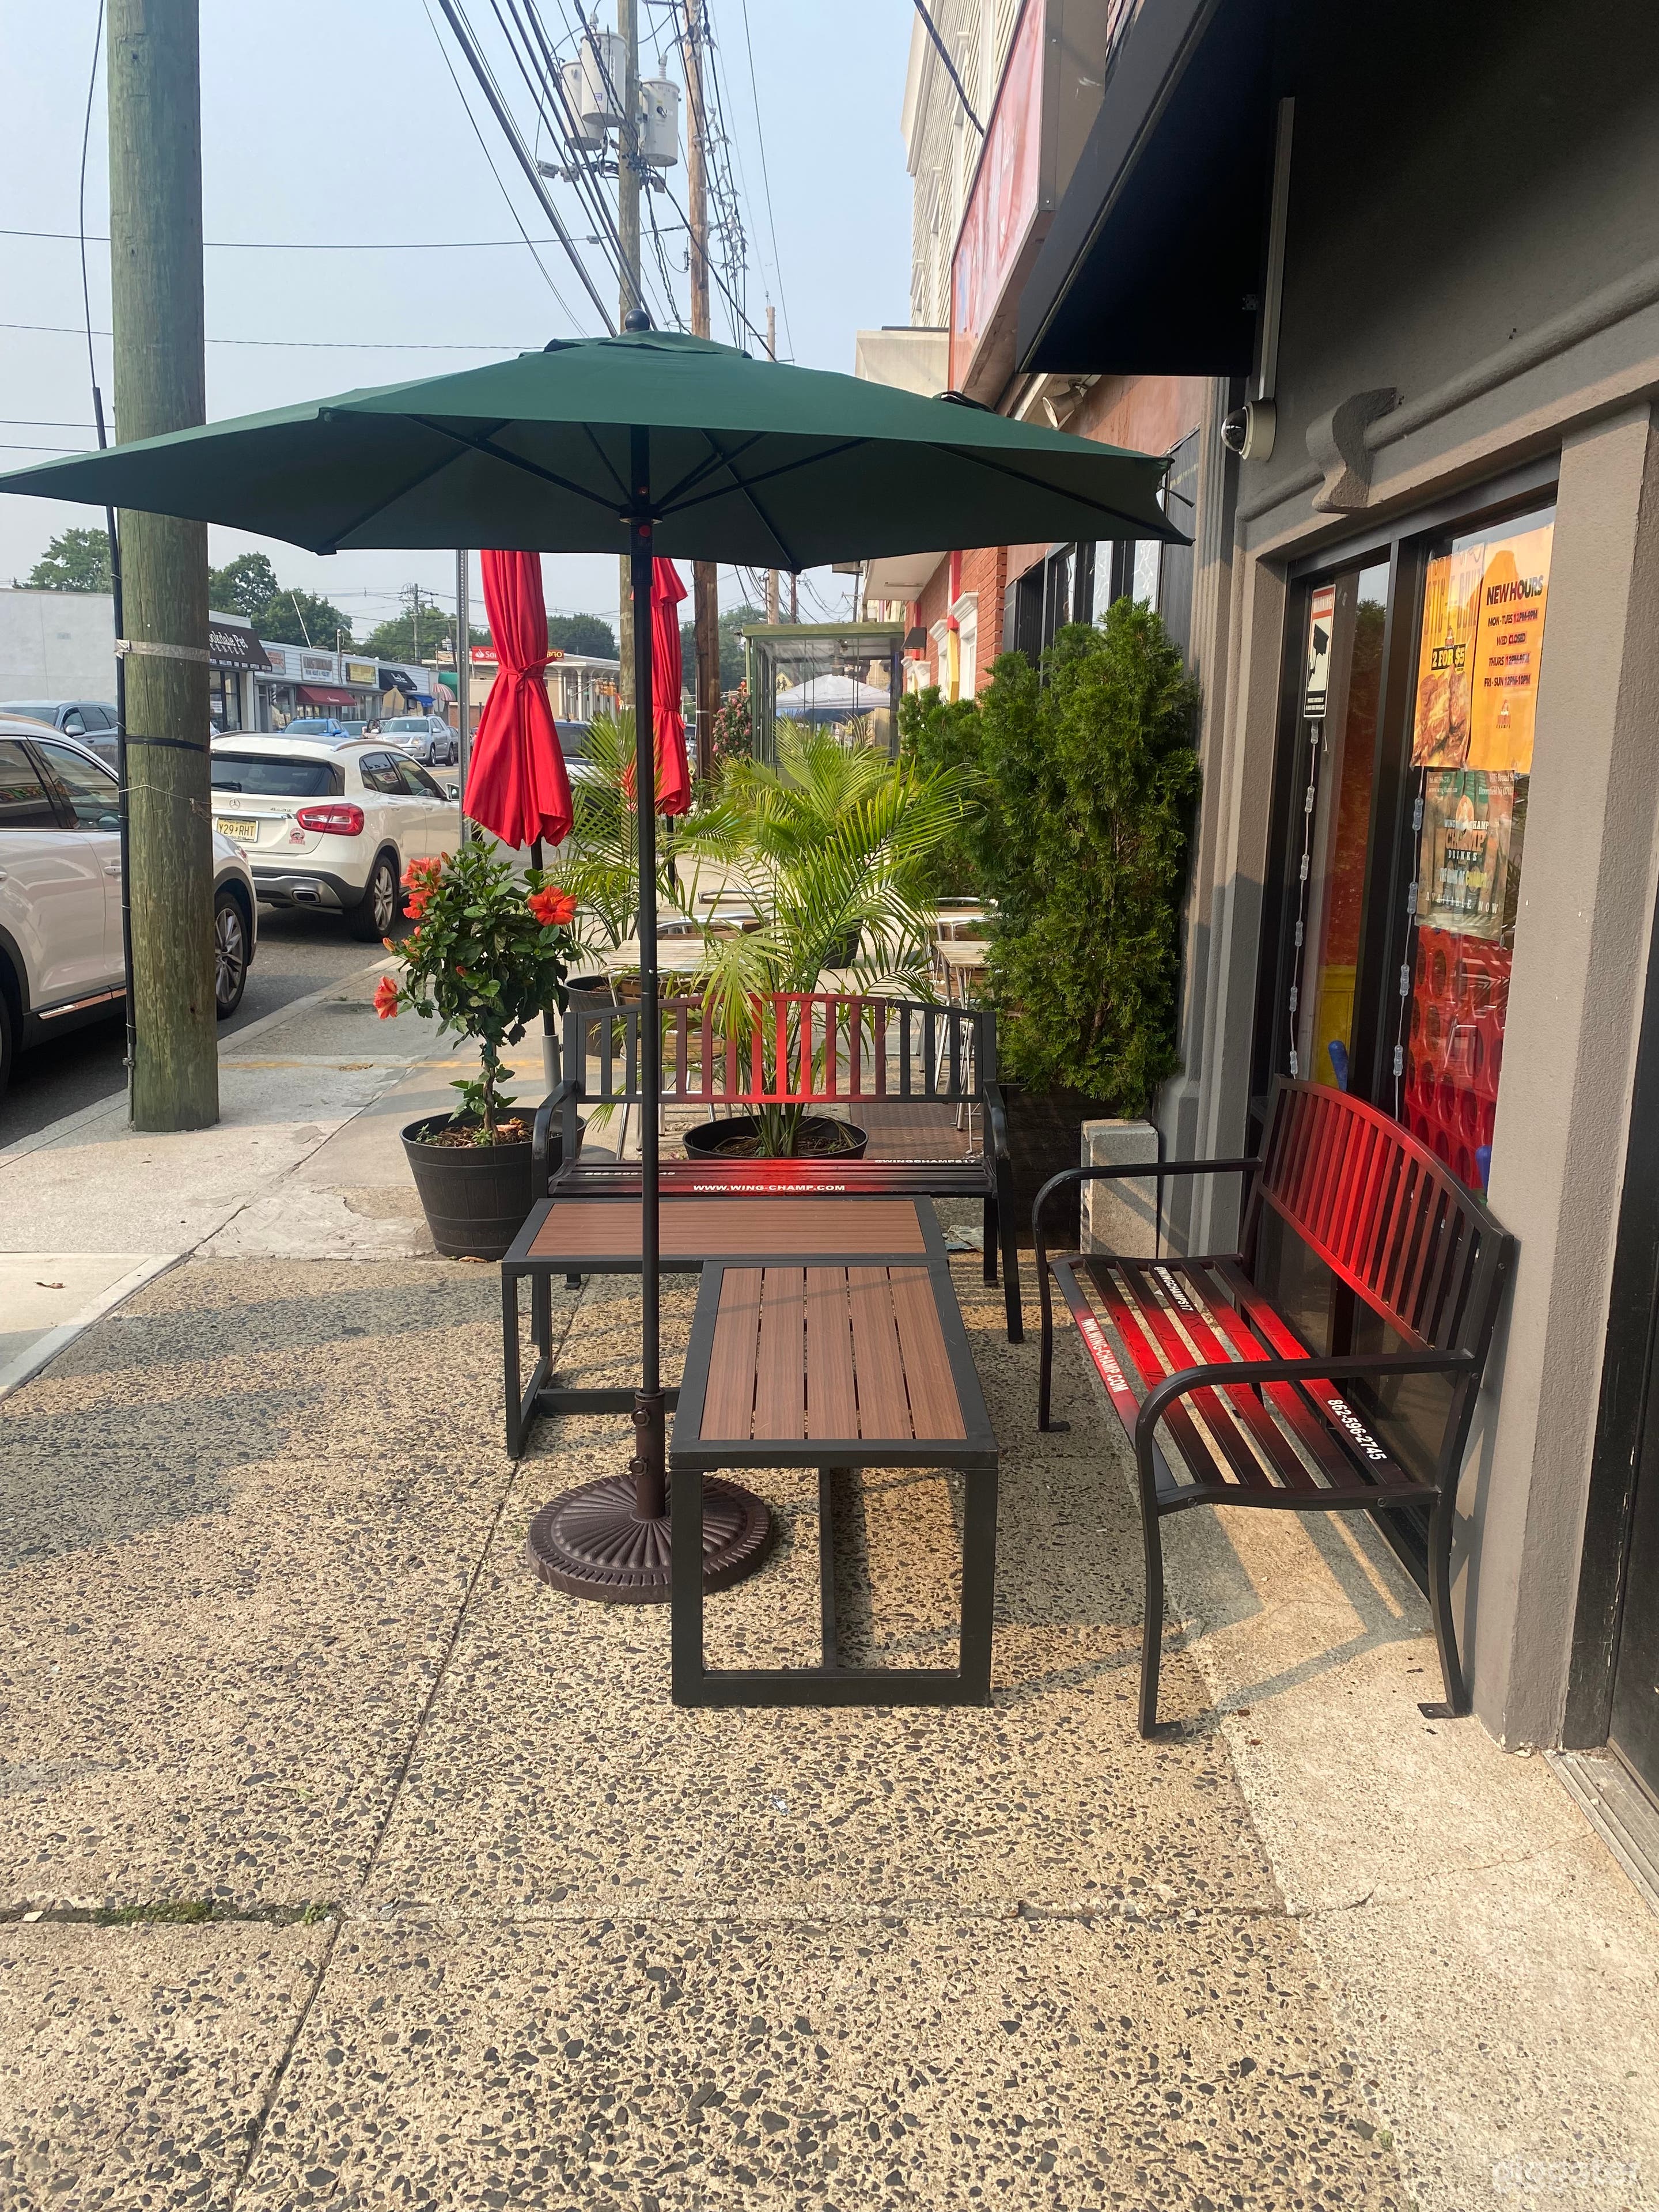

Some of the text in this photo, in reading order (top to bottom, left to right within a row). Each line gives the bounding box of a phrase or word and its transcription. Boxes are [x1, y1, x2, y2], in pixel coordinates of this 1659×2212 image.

[1486, 575, 1544, 605] NEW HOURS
[1488, 616, 1500, 627] MON
[1502, 614, 1513, 625] TUES
[232, 634, 248, 649] Pet
[1497, 632, 1526, 646] WED CLOSED
[210, 643, 245, 655] CENTER
[1432, 645, 1465, 668] 2 FOR $5
[1489, 656, 1504, 666] THURS
[1494, 676, 1503, 687] SUN
[1498, 772, 1509, 782] Broad
[1448, 850, 1478, 861] DRINKS
[1426, 892, 1499, 914] AVAILABLE NOW
[1154, 1267, 1194, 1311] @WINGCHAMPS17
[1081, 1318, 1129, 1393] WWW.WING-CHAMP.COM
[1327, 1399, 1388, 1460] 862-596-2745
